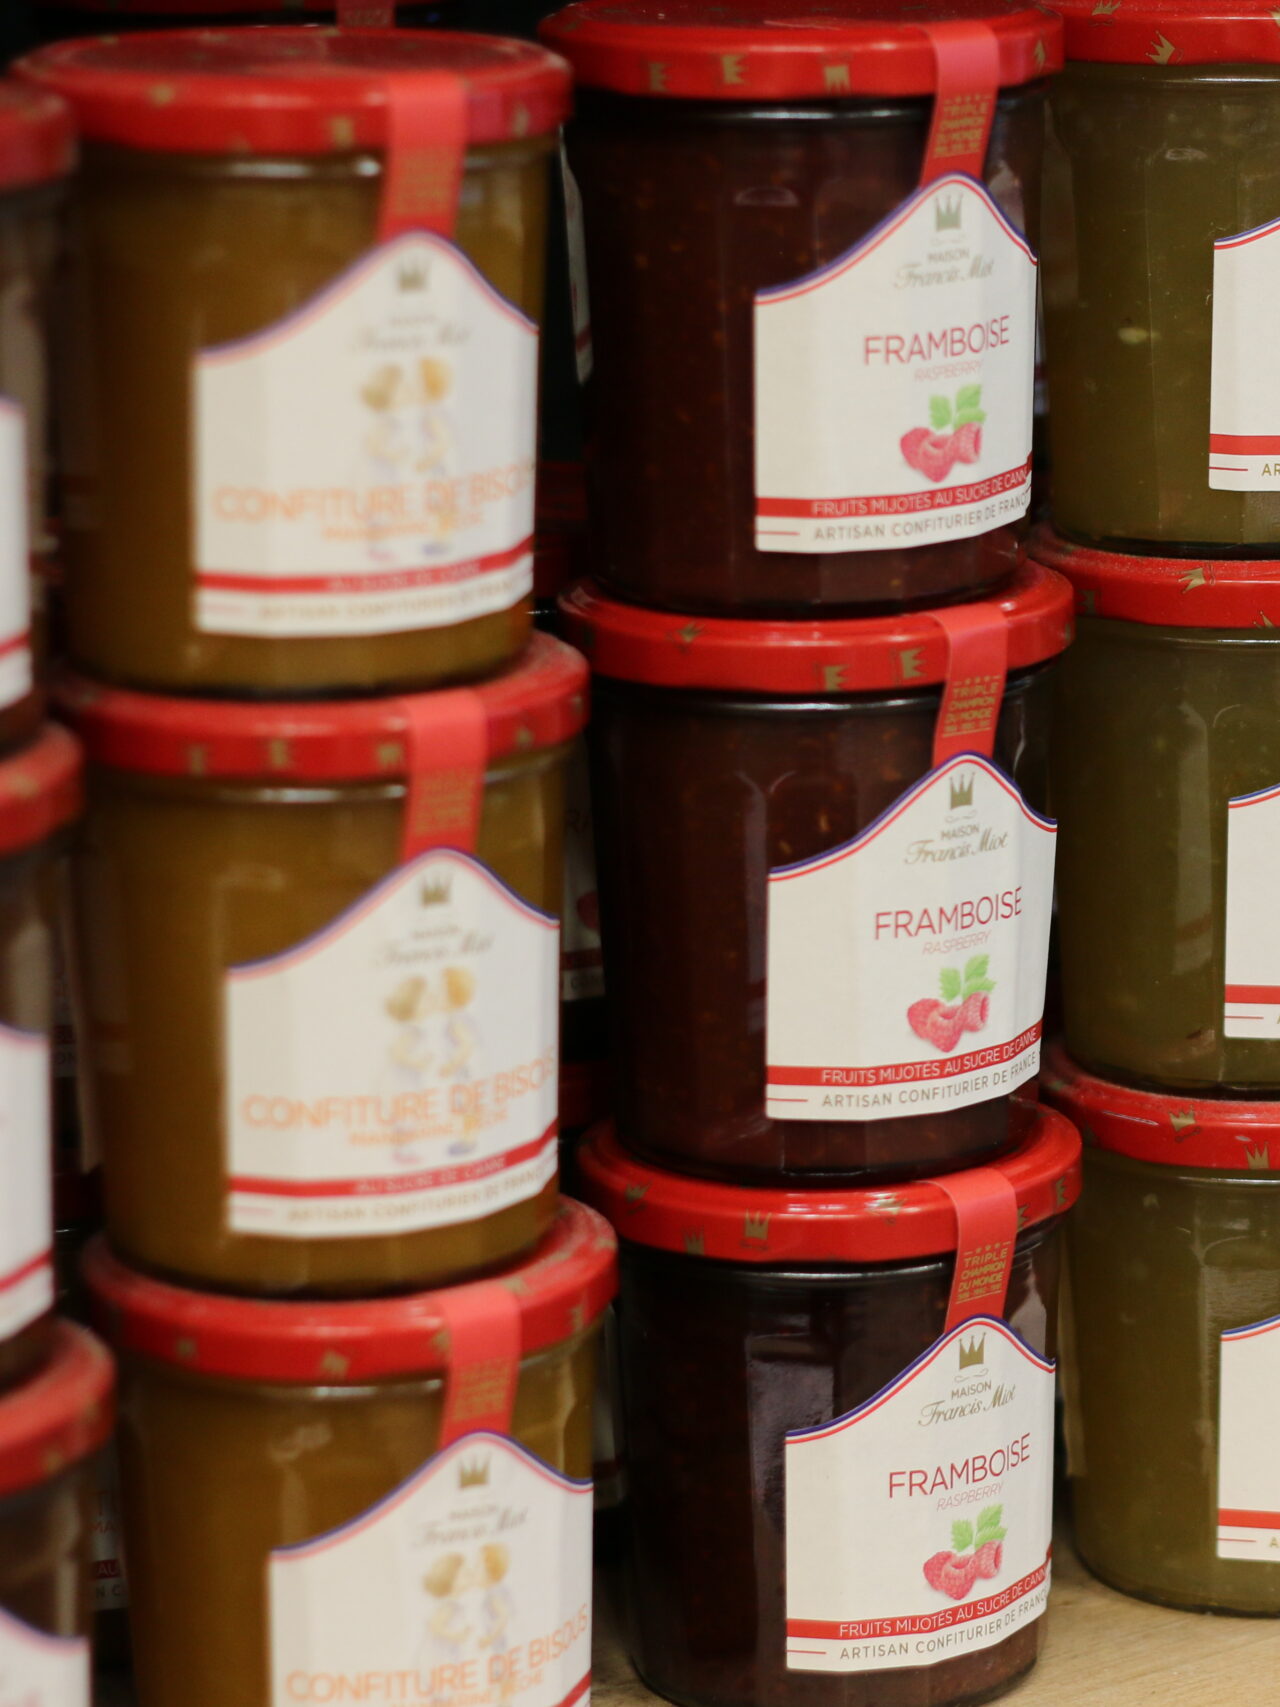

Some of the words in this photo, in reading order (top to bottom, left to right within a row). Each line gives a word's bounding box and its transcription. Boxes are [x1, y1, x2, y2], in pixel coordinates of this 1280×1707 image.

[864, 315, 1010, 366] FRAMBOISE
[812, 499, 868, 516] FRUITS
[934, 489, 953, 506] AU
[955, 483, 991, 504] SUCRE
[991, 477, 1004, 493] DE
[814, 524, 886, 541] ARTISAN
[891, 509, 983, 538] CONFITURIER
[984, 504, 996, 520] DE
[904, 839, 970, 865] Francis
[971, 827, 1008, 856] Miot
[941, 823, 980, 840] MAISON
[874, 886, 1022, 940] FRAMBOISE
[922, 929, 992, 956] RASPBERRY
[822, 1069, 876, 1084] FRUITS
[879, 1061, 941, 1082] MIJOTÉS
[944, 1058, 962, 1074] AU
[963, 1049, 1000, 1071] SUCRE
[1003, 1044, 1015, 1061] DE
[1015, 1028, 1037, 1056] CANNE
[822, 1092, 893, 1108] ARTISAN
[899, 1075, 989, 1104] CONFITURIER
[993, 1069, 1008, 1085] DE
[1010, 1050, 1036, 1080] FRANCE
[964, 1248, 1008, 1268] TRIPLE
[972, 1272, 1003, 1288] MONDE
[918, 1398, 982, 1427] Francis
[982, 1384, 1016, 1412] Miot
[951, 1380, 992, 1400] MAISON
[889, 1432, 1031, 1499] FRAMBOISE
[936, 1481, 1004, 1512] RASPBERRY
[839, 1622, 892, 1637] FRUITS
[896, 1611, 953, 1634] MIJOTÉS
[956, 1606, 974, 1623] AU
[977, 1590, 1010, 1617] SUCRE
[1011, 1582, 1024, 1599] DE
[1024, 1567, 1046, 1591] CANN
[840, 1643, 909, 1660] ARTISAN
[915, 1619, 1003, 1653] CONFITURIER
[1004, 1608, 1016, 1626] DE
[1018, 1588, 1047, 1618] FRANC
[285, 1659, 478, 1703] CONFITURE
[487, 1646, 522, 1685] DE
